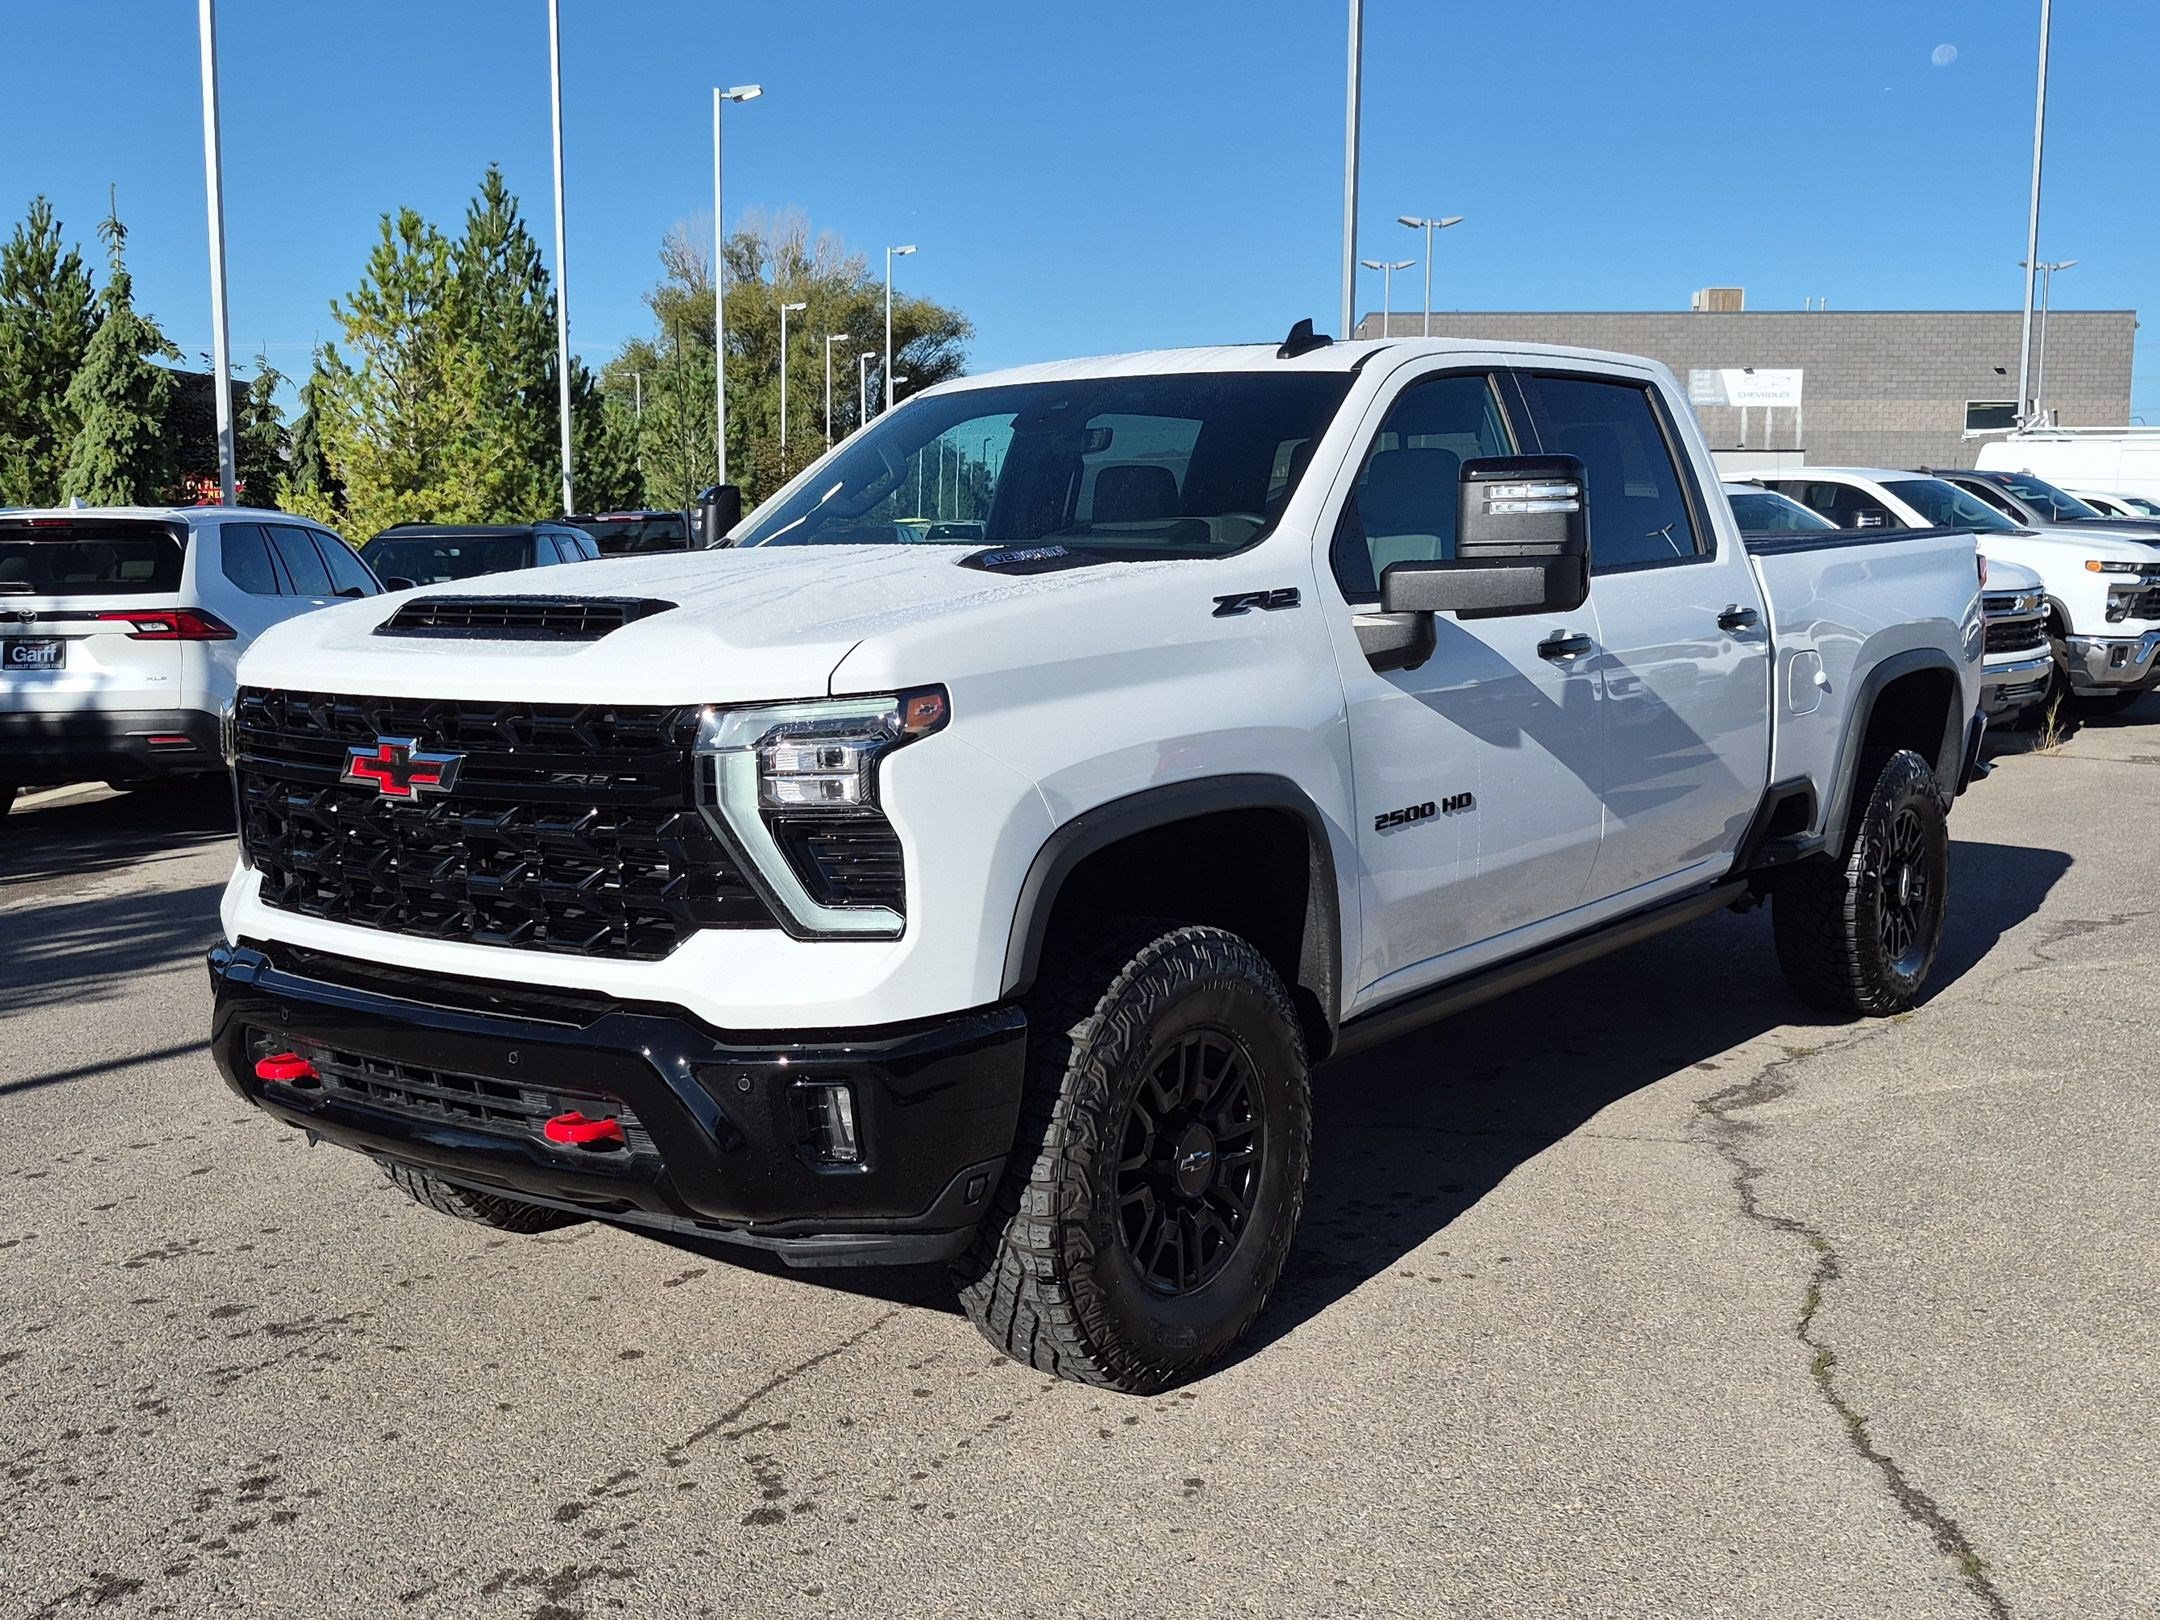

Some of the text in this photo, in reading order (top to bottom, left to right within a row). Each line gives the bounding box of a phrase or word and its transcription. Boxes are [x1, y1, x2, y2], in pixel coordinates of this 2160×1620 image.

[1737, 391, 1792, 399] CHEVROLET
[1211, 586, 1301, 618] ZR2
[12, 643, 57, 663] Garff
[550, 773, 609, 785] ZR2
[1374, 792, 1473, 832] 2500 HD
